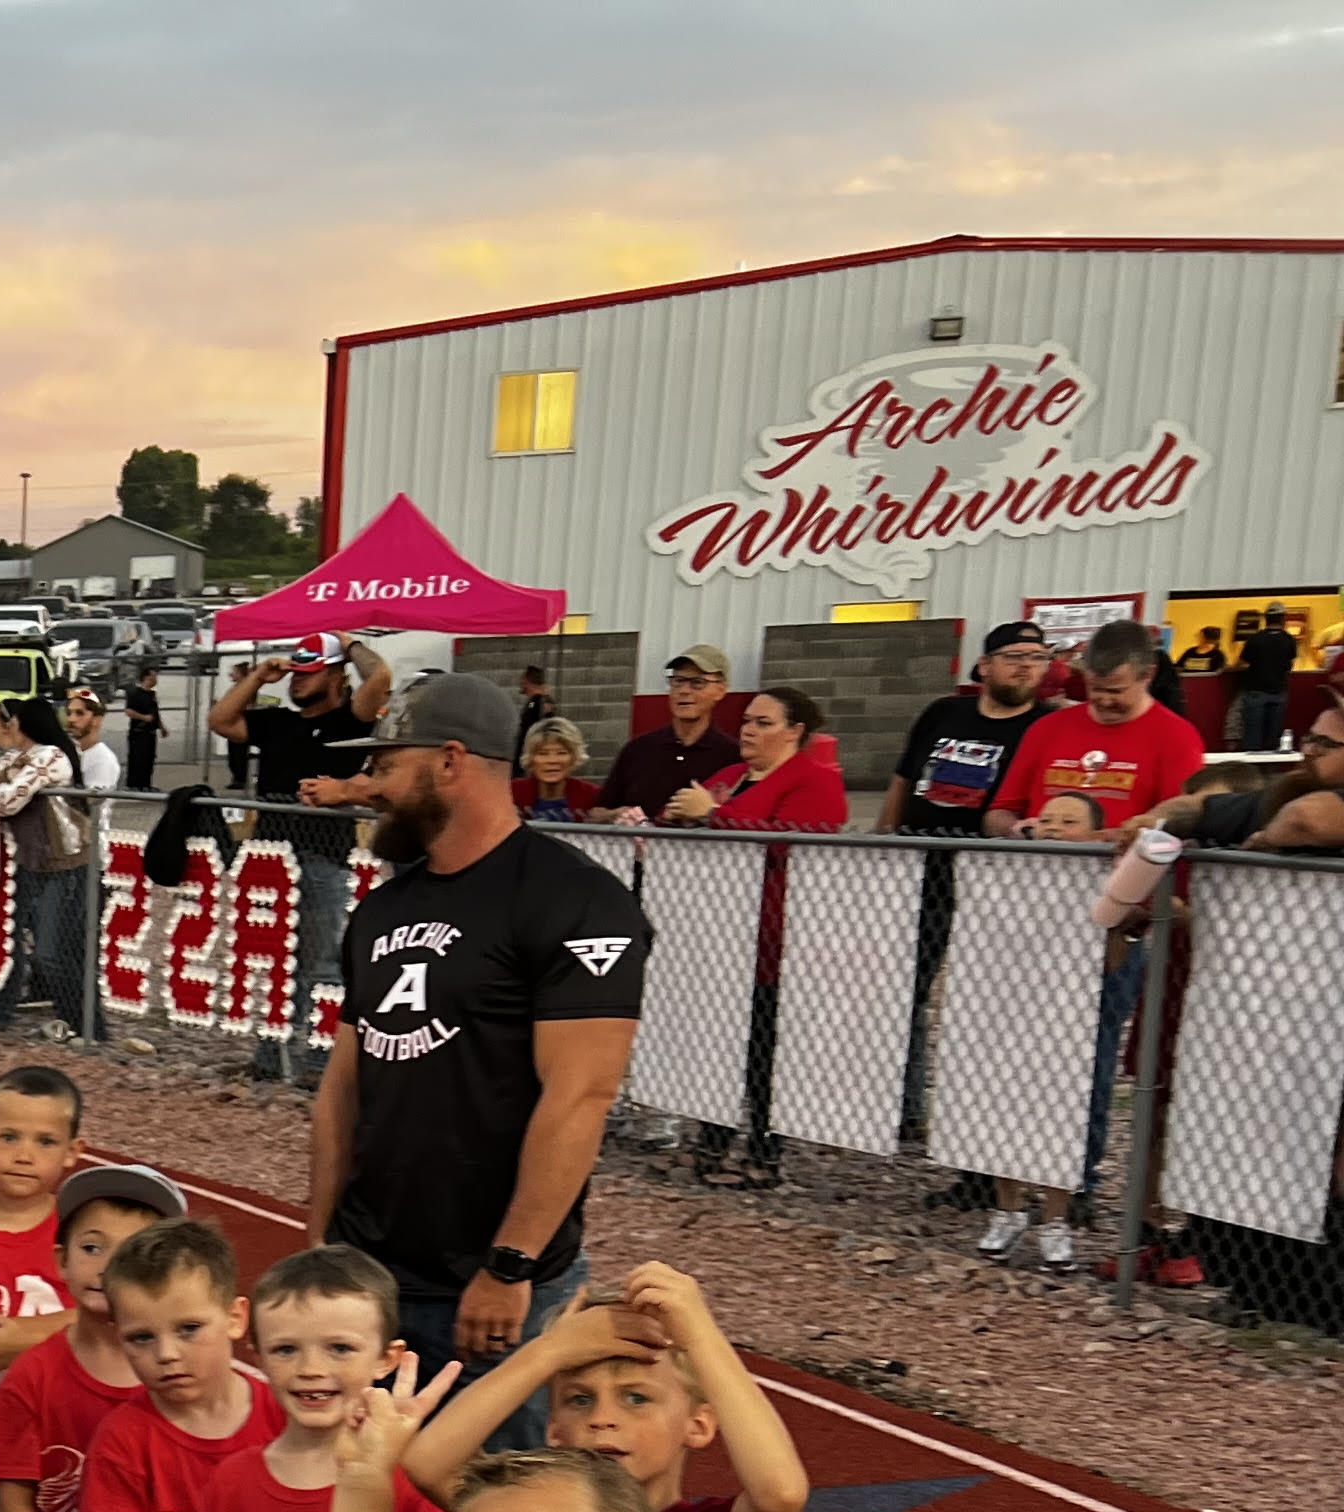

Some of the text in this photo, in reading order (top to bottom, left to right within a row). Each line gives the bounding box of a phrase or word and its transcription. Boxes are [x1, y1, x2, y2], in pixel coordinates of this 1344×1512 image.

[759, 353, 1086, 480] Archie
[657, 432, 1199, 573] Whirlwinds
[344, 575, 471, 601] Mobile
[370, 922, 462, 963] ARCHIE
[375, 962, 428, 1013] A
